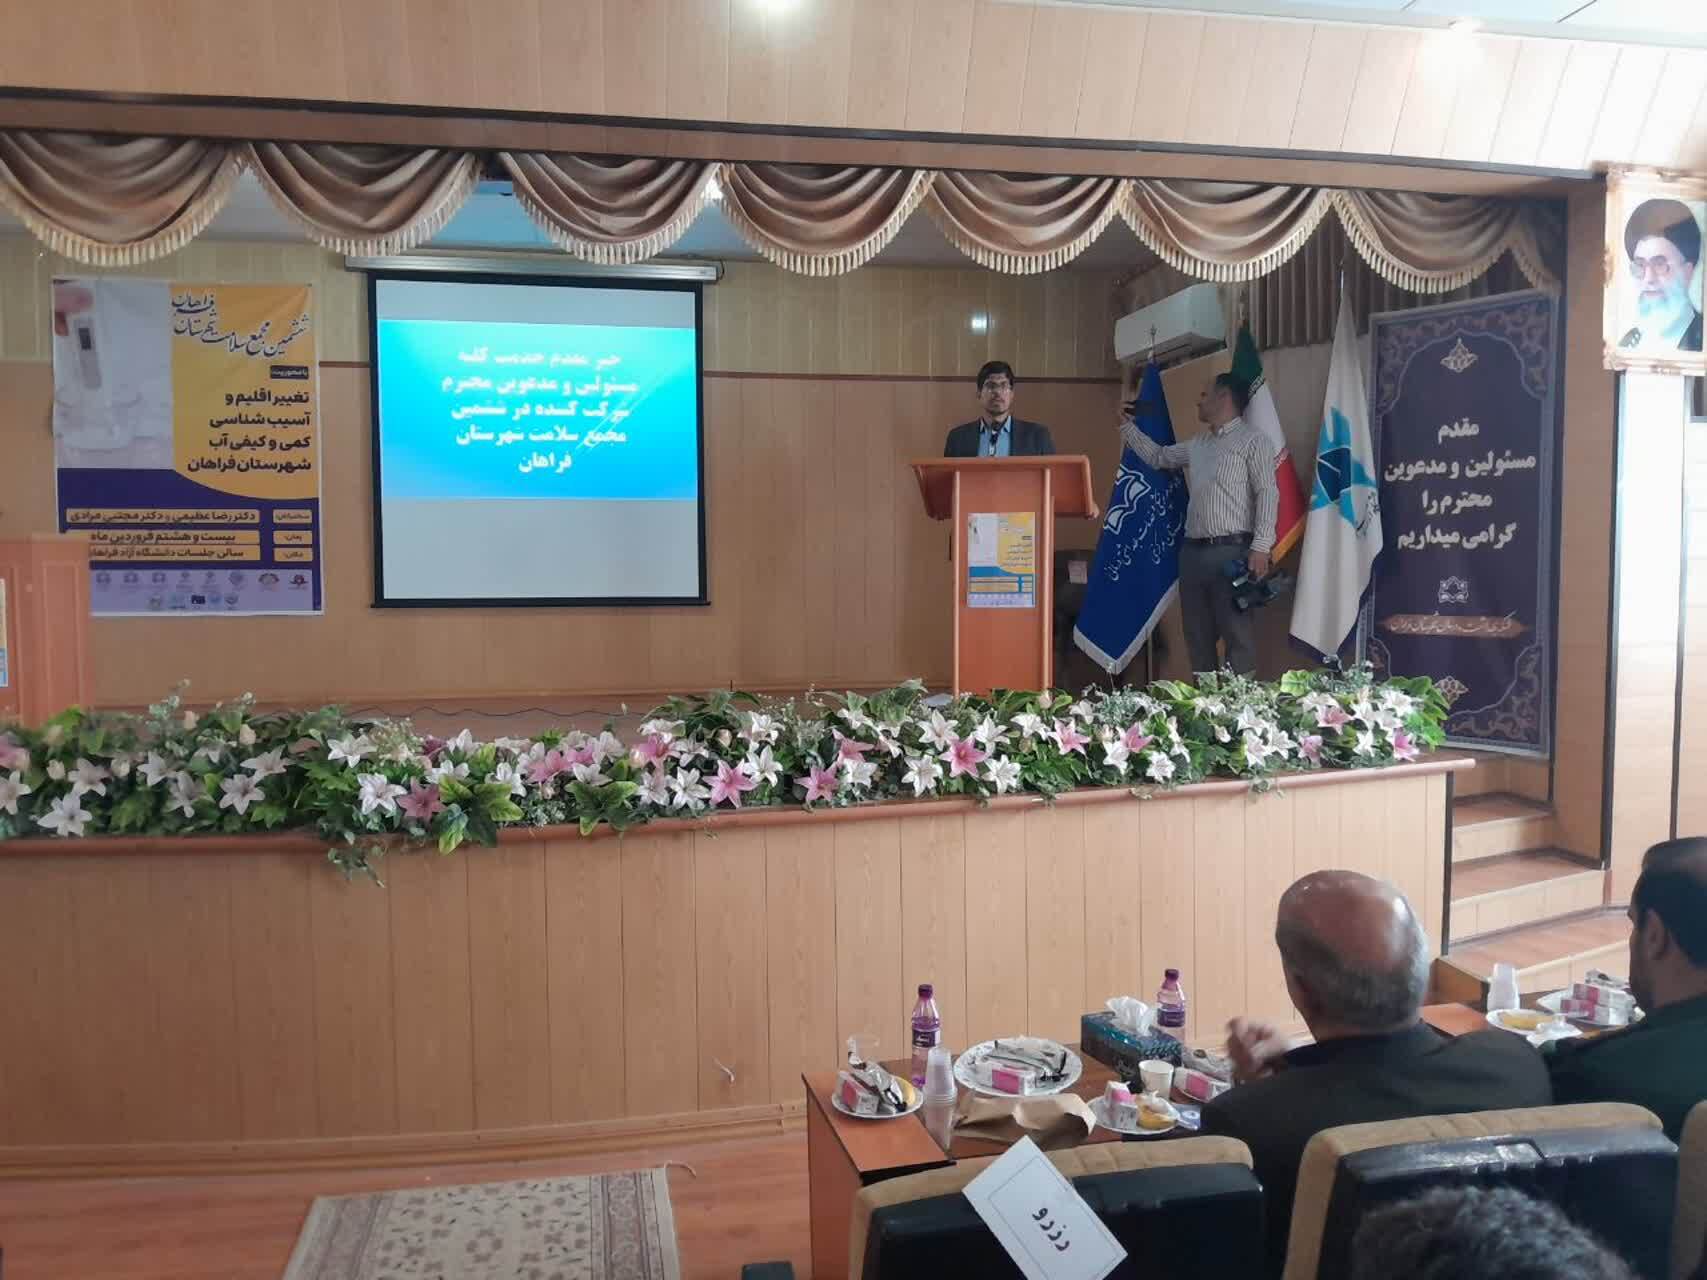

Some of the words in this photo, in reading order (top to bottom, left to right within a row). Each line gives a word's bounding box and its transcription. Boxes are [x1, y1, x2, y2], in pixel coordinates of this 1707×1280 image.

[201, 331, 245, 353] سلامت
[263, 313, 309, 357] ششمین
[235, 387, 271, 407] اقلیم
[562, 381, 572, 396] و
[225, 392, 234, 406] و
[272, 391, 310, 406] تغییر
[512, 401, 531, 421] در
[209, 412, 266, 429] شناسی
[267, 411, 311, 429] آسیب
[455, 424, 525, 446] شهرستان
[528, 424, 579, 442] سلامت
[583, 428, 627, 448] مجمع
[1437, 417, 1480, 445] مقدم
[209, 432, 229, 450] آب
[229, 434, 267, 450] کیفی
[269, 438, 278, 451] و
[279, 436, 312, 451] کمی
[187, 455, 237, 473] فراهان
[237, 458, 312, 473] شهرستان
[518, 451, 573, 473] فراهان
[1384, 459, 1448, 482] مدعوین
[1449, 461, 1460, 479] و
[1465, 449, 1537, 478] مسئولین
[1422, 489, 1439, 515] را
[1440, 491, 1493, 514] محترم
[139, 511, 163, 523] دکتر
[171, 511, 211, 523] عظیمی
[212, 511, 233, 523] رضا
[233, 511, 255, 523] دکتر
[90, 531, 109, 542] ماه
[112, 532, 154, 545] فروردین
[154, 532, 192, 545] هشتم
[193, 534, 199, 543] و
[200, 532, 236, 545] بیست
[1461, 522, 1517, 549] گرامی
[178, 547, 215, 559] جلسات
[217, 547, 244, 560] سالن
[1032, 1207, 1070, 1252] رزرو
